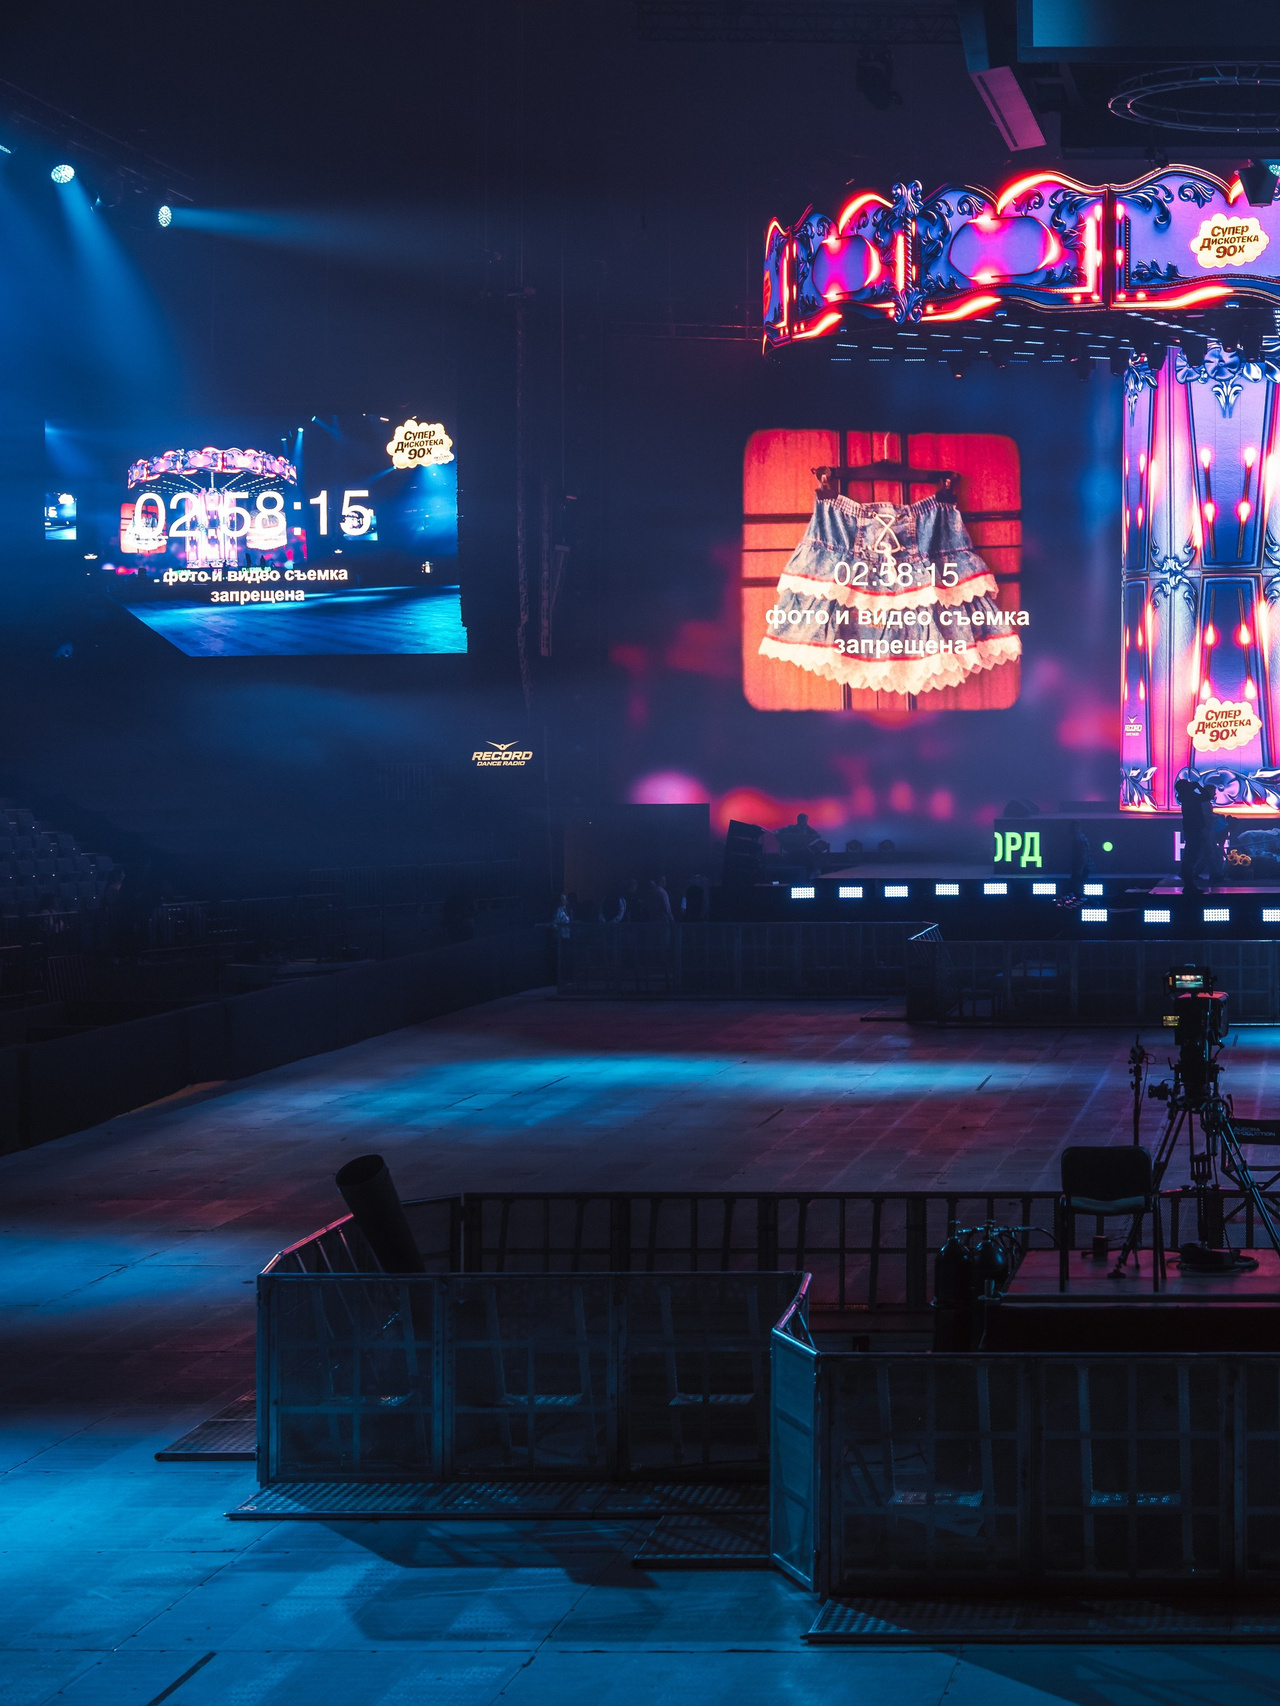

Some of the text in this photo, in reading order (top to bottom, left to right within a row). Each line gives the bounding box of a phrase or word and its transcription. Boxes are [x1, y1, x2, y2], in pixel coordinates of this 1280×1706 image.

[134, 489, 372, 538] 02:58:15
[163, 568, 349, 586] фото и видео съемка
[833, 561, 960, 588] 02:58:15
[210, 589, 305, 606] запрещена
[764, 604, 1030, 631] фото и видео съемка
[833, 637, 968, 658] запрещена
[471, 750, 533, 761] RECORD
